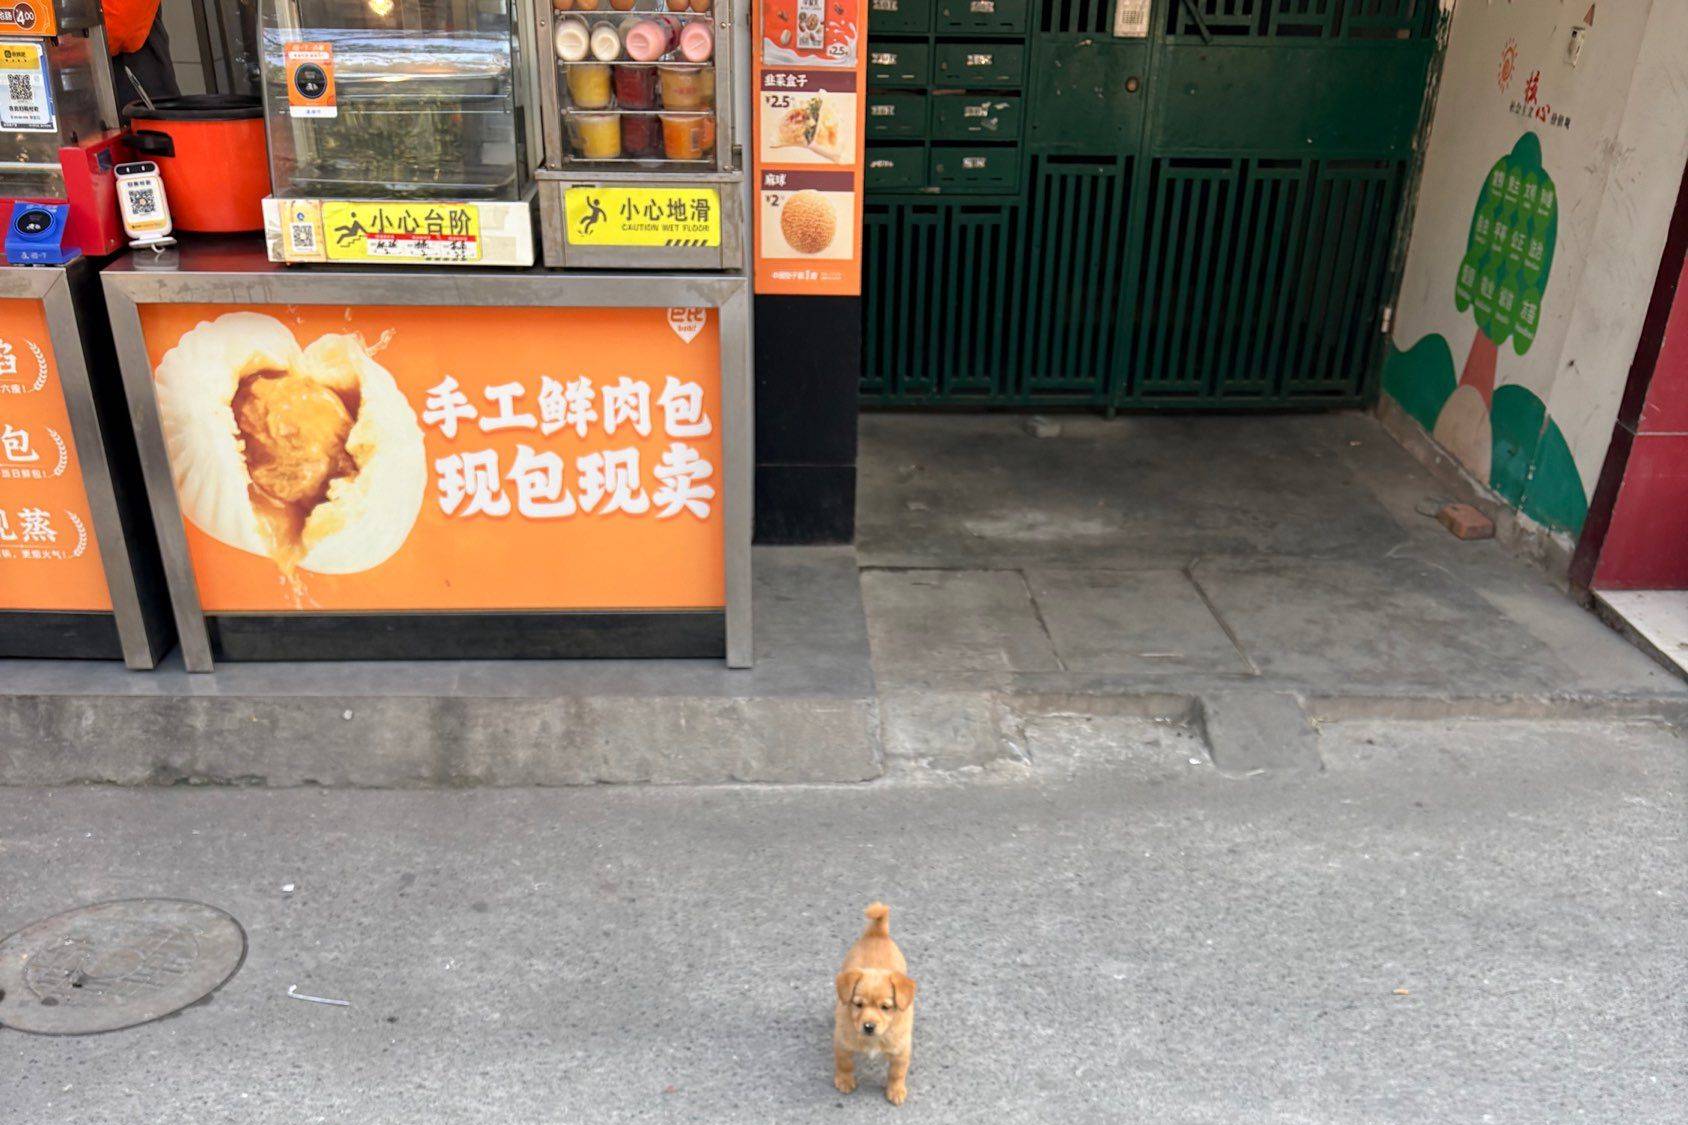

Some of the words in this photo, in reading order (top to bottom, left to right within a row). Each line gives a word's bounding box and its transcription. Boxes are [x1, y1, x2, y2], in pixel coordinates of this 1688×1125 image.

[371, 208, 472, 236] 小心台阶
[620, 197, 711, 222] 小心地滑
[622, 223, 659, 232] CAUTION
[662, 224, 679, 232] WET
[683, 224, 710, 232] FLOOR
[422, 374, 713, 438] 手工鲜肉包
[0, 423, 40, 462] 包
[435, 443, 716, 519] 现包现卖
